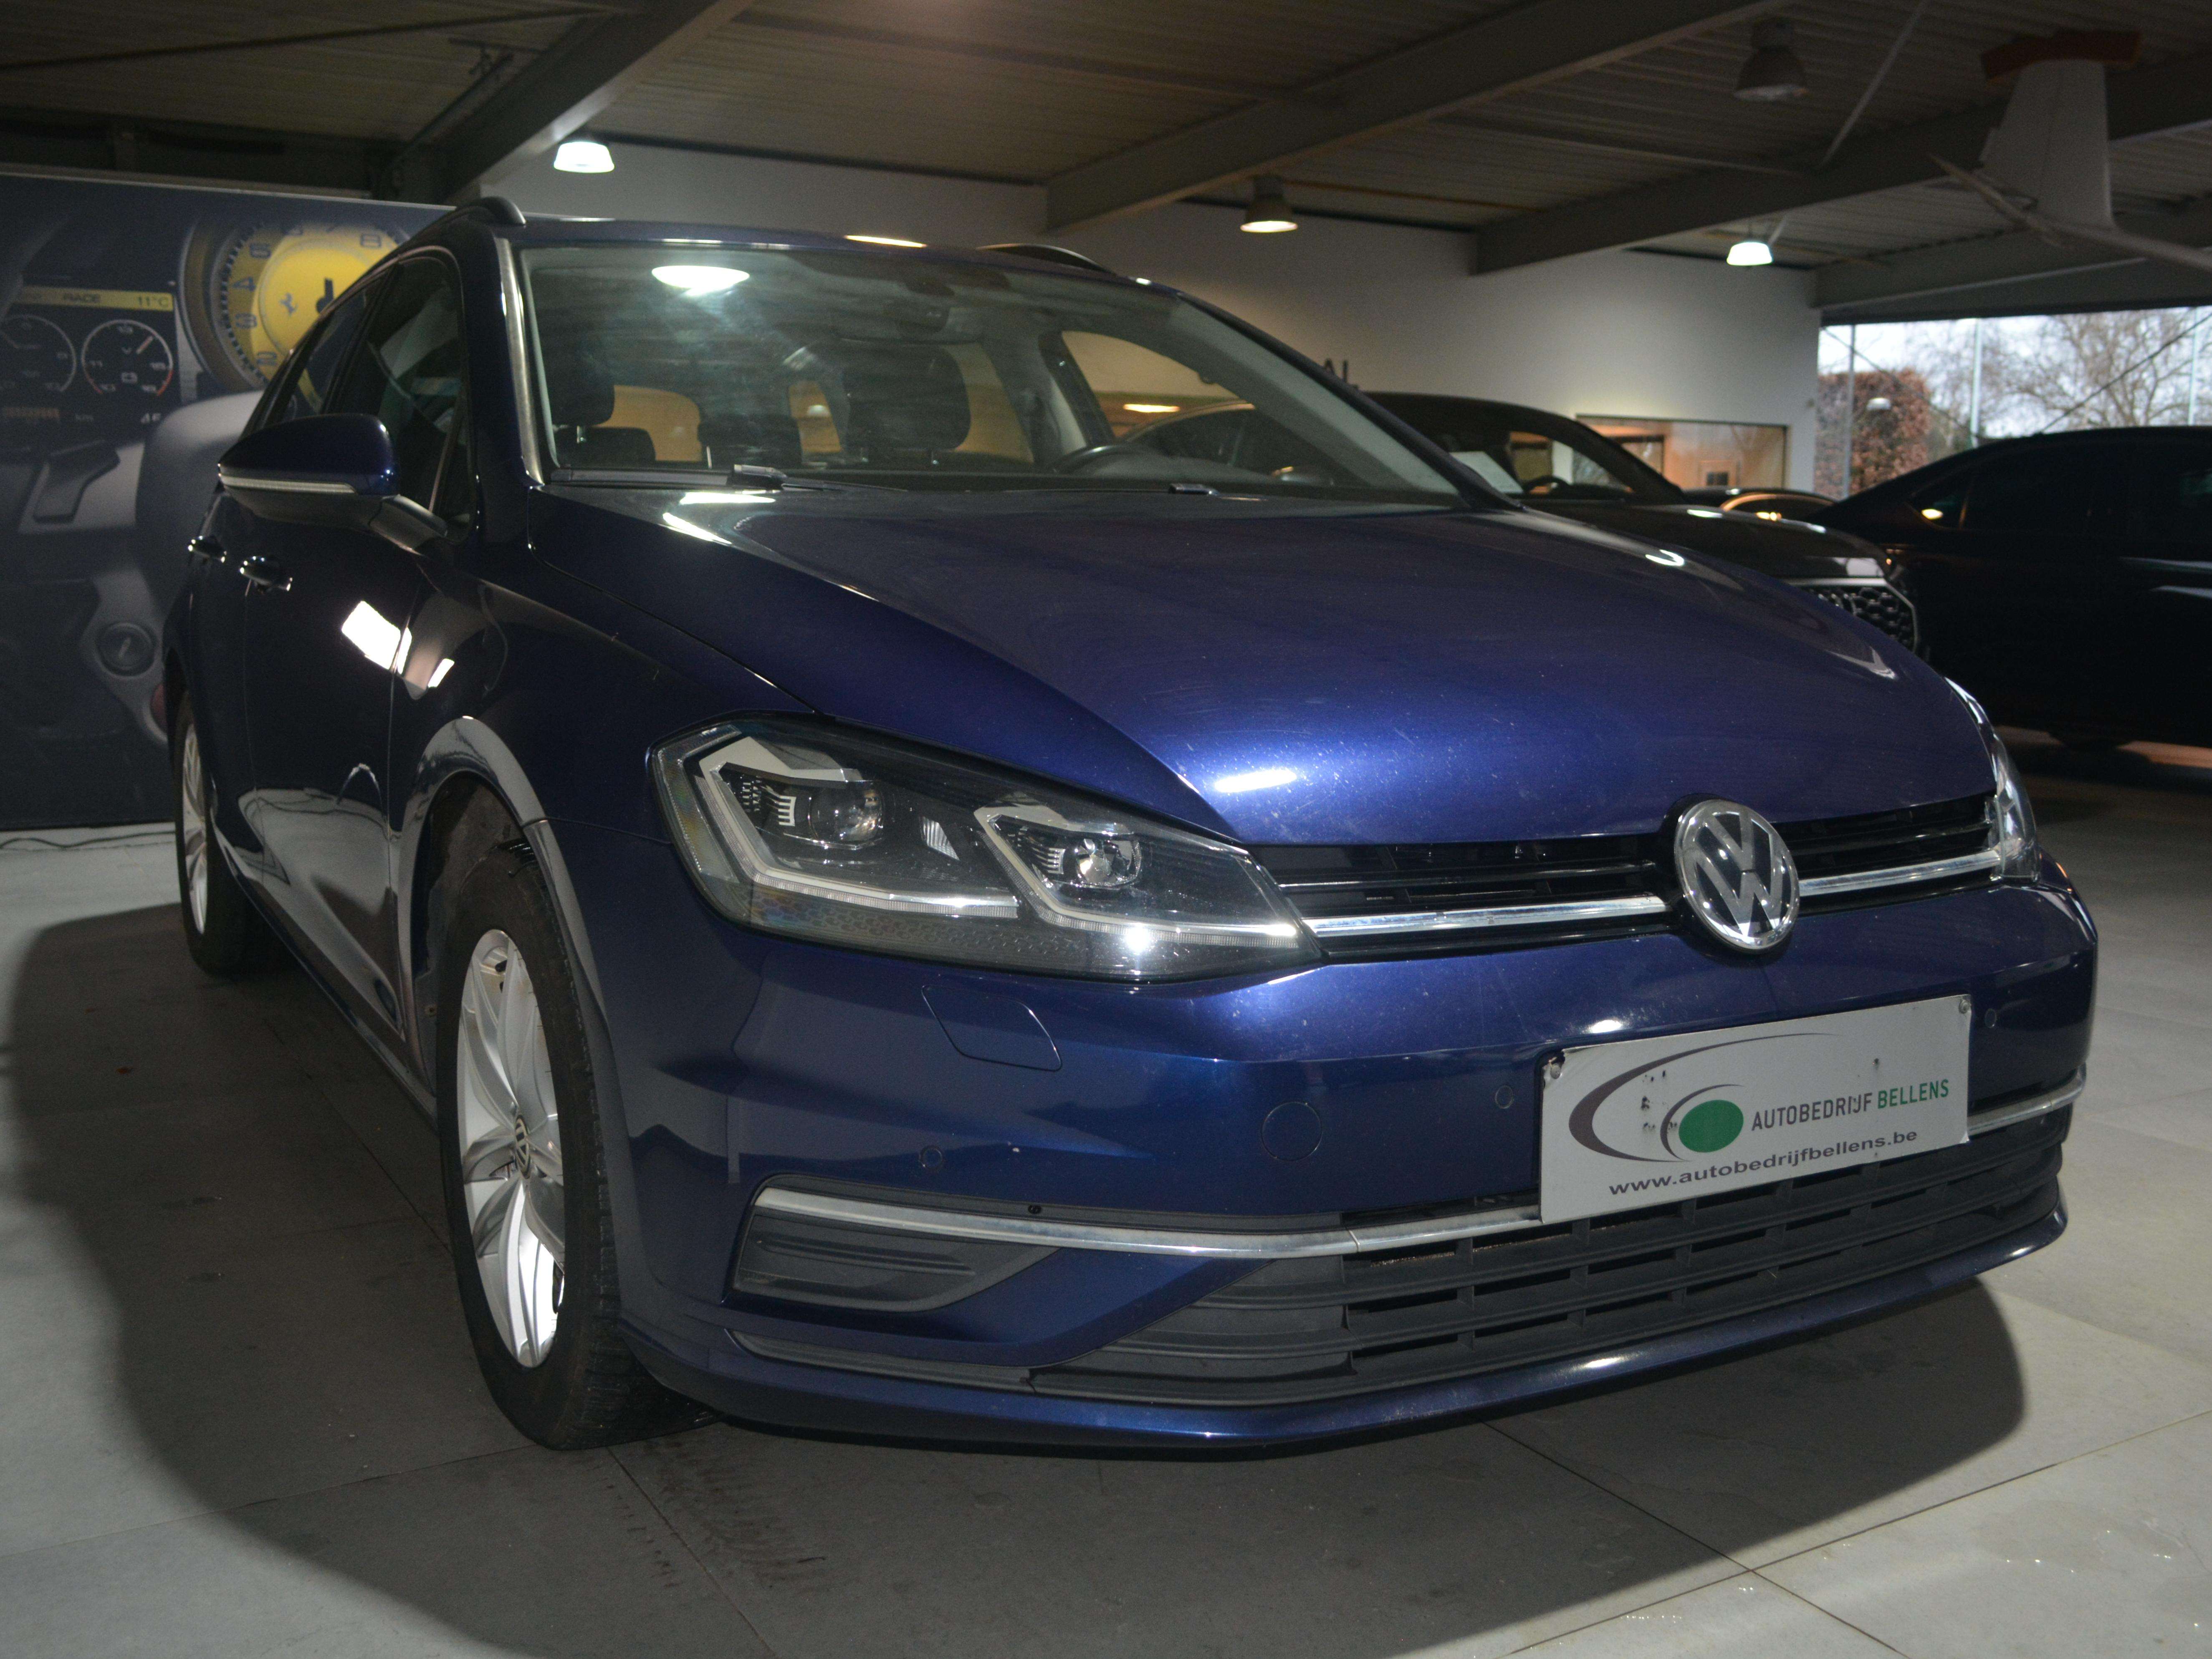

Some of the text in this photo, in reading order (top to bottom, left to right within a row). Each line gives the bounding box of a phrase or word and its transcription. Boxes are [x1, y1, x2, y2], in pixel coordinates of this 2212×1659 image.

[233, 276, 255, 292] 4
[235, 313, 258, 329] 3
[1752, 1079, 1949, 1131] AUTOBEDRIJF BELLENS
[1608, 1130, 1918, 1196] www.autobedrijfbellens.be
